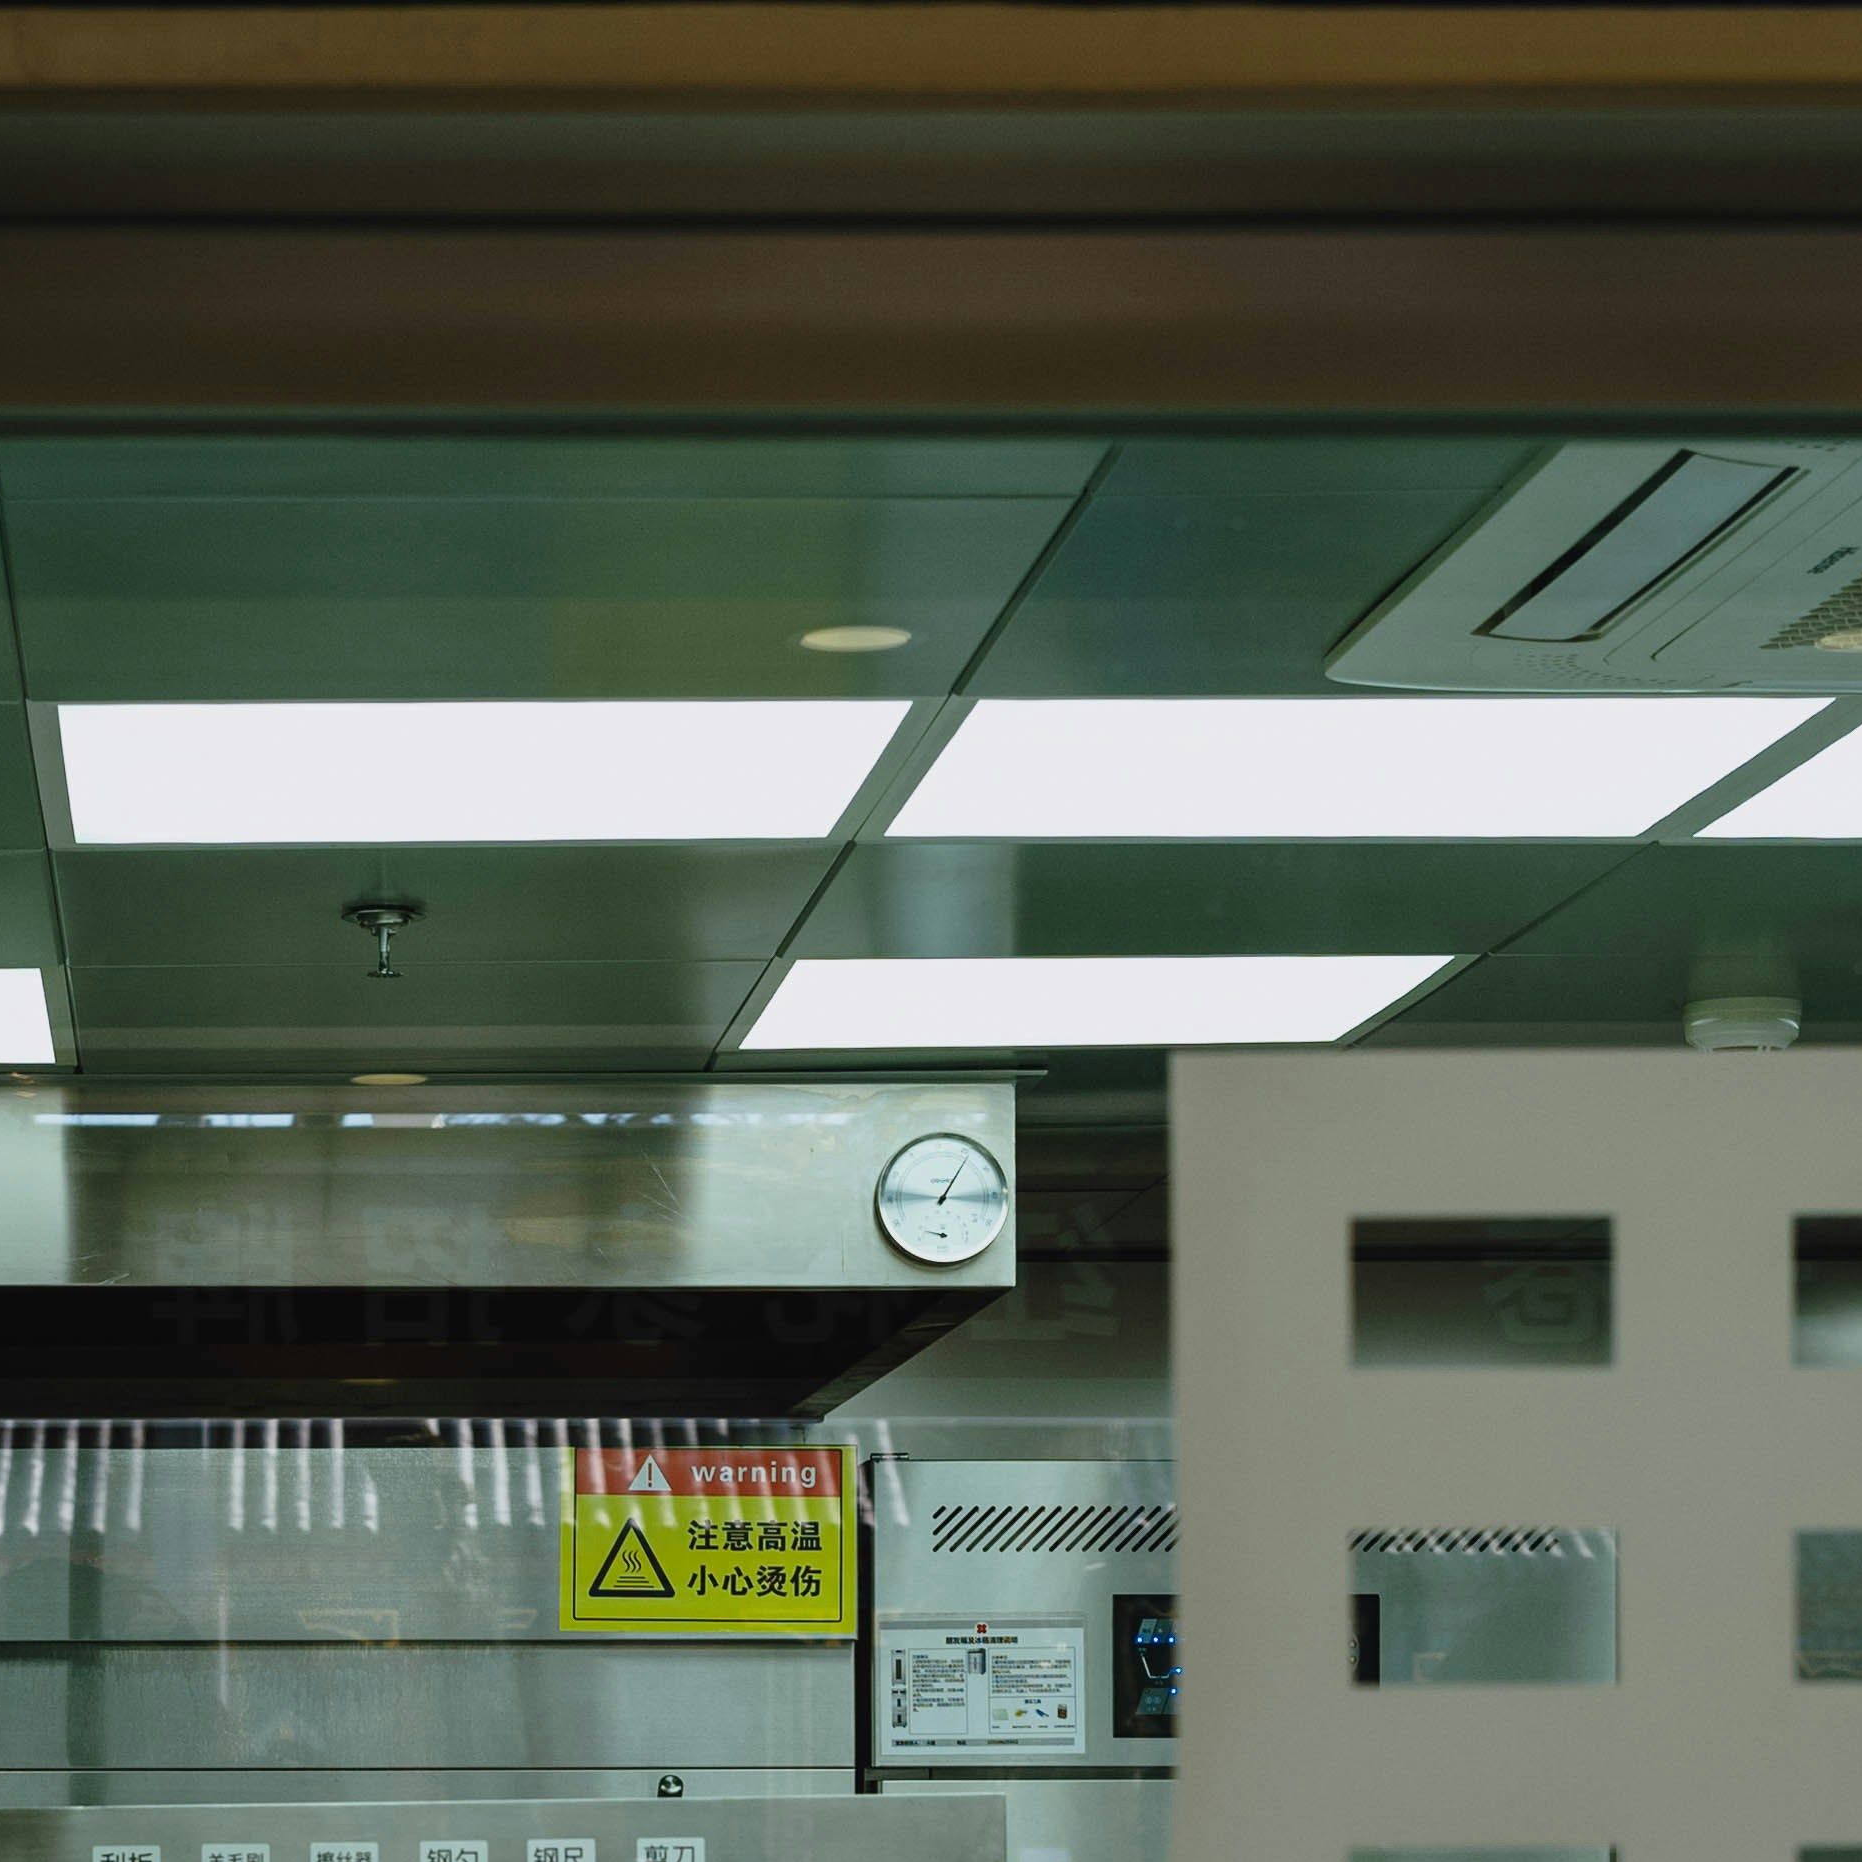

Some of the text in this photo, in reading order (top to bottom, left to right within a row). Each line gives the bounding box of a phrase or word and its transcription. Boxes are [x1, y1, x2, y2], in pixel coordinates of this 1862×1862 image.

[691, 1460, 818, 1490] warning
[687, 1519, 823, 1553] 注意高温
[687, 1564, 823, 1598] 小心烫伤
